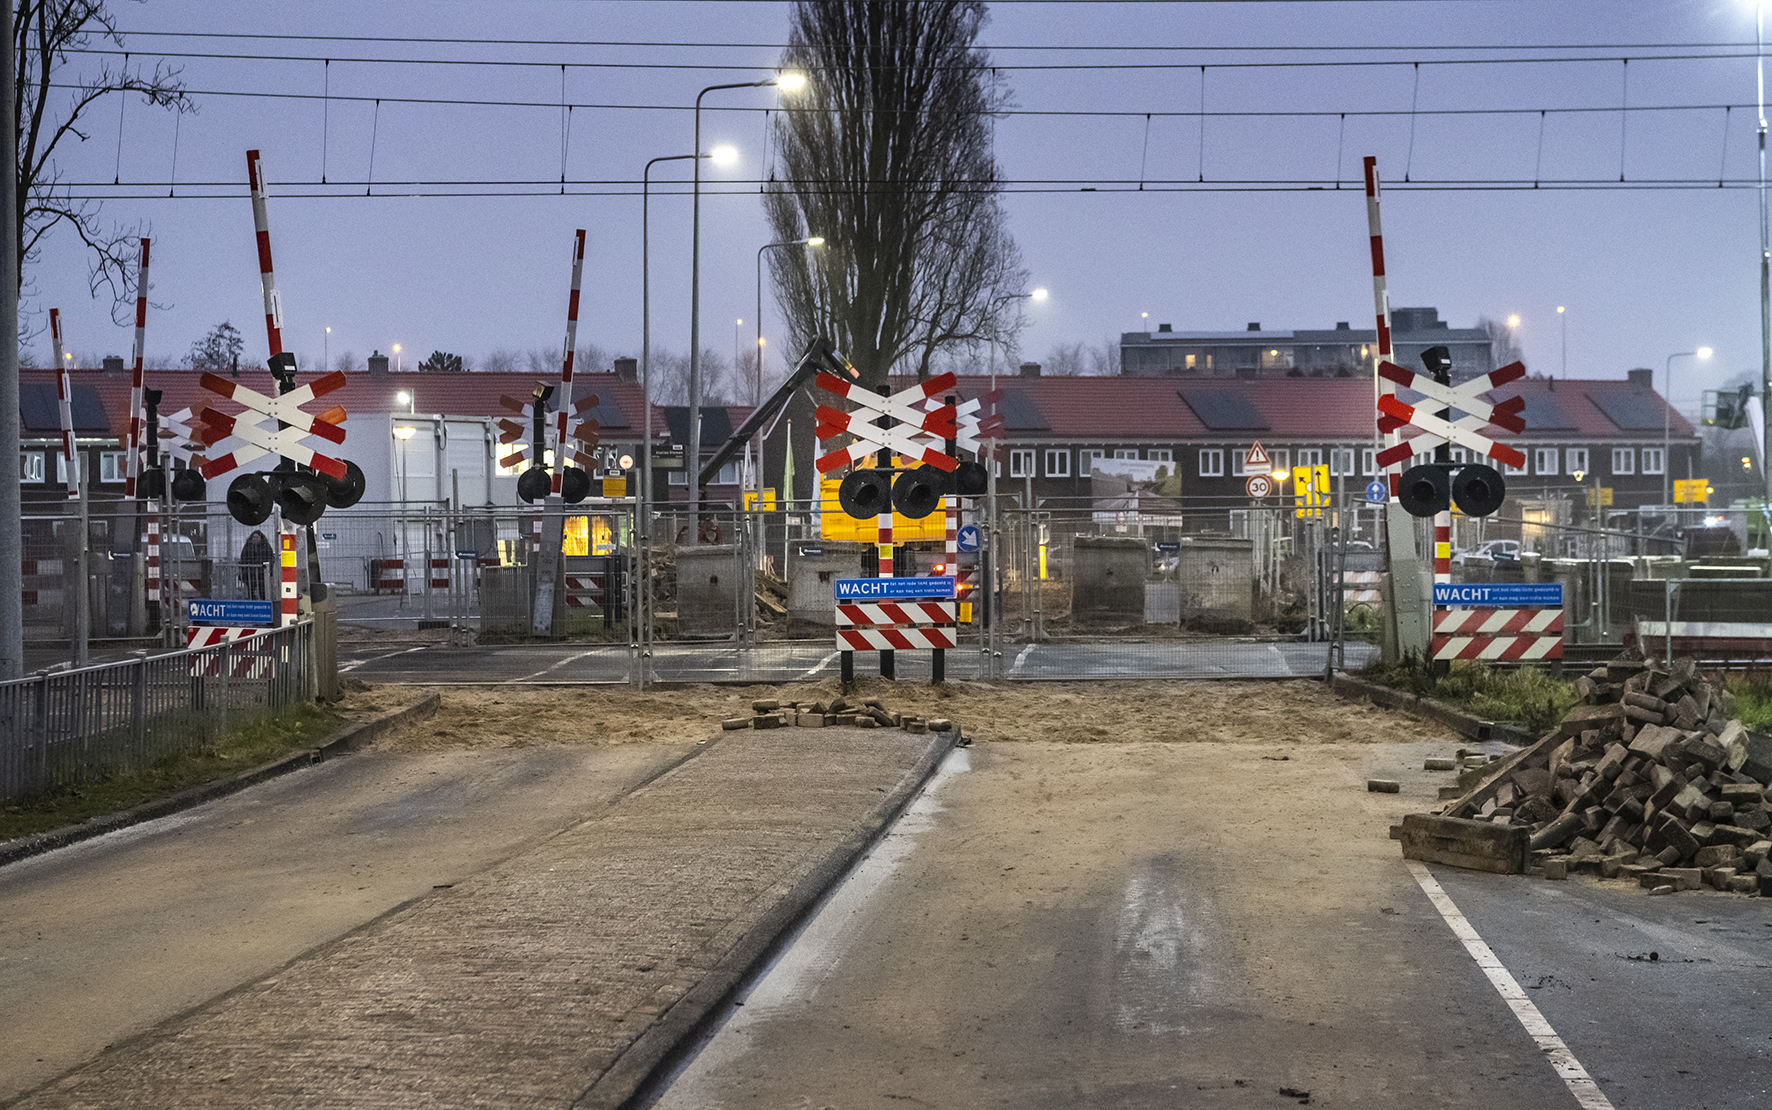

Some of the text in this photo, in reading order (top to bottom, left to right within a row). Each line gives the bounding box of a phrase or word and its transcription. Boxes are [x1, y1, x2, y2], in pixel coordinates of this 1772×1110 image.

[1252, 483, 1266, 492] 30
[839, 583, 889, 594] WACHT
[1436, 588, 1491, 600] WACHT
